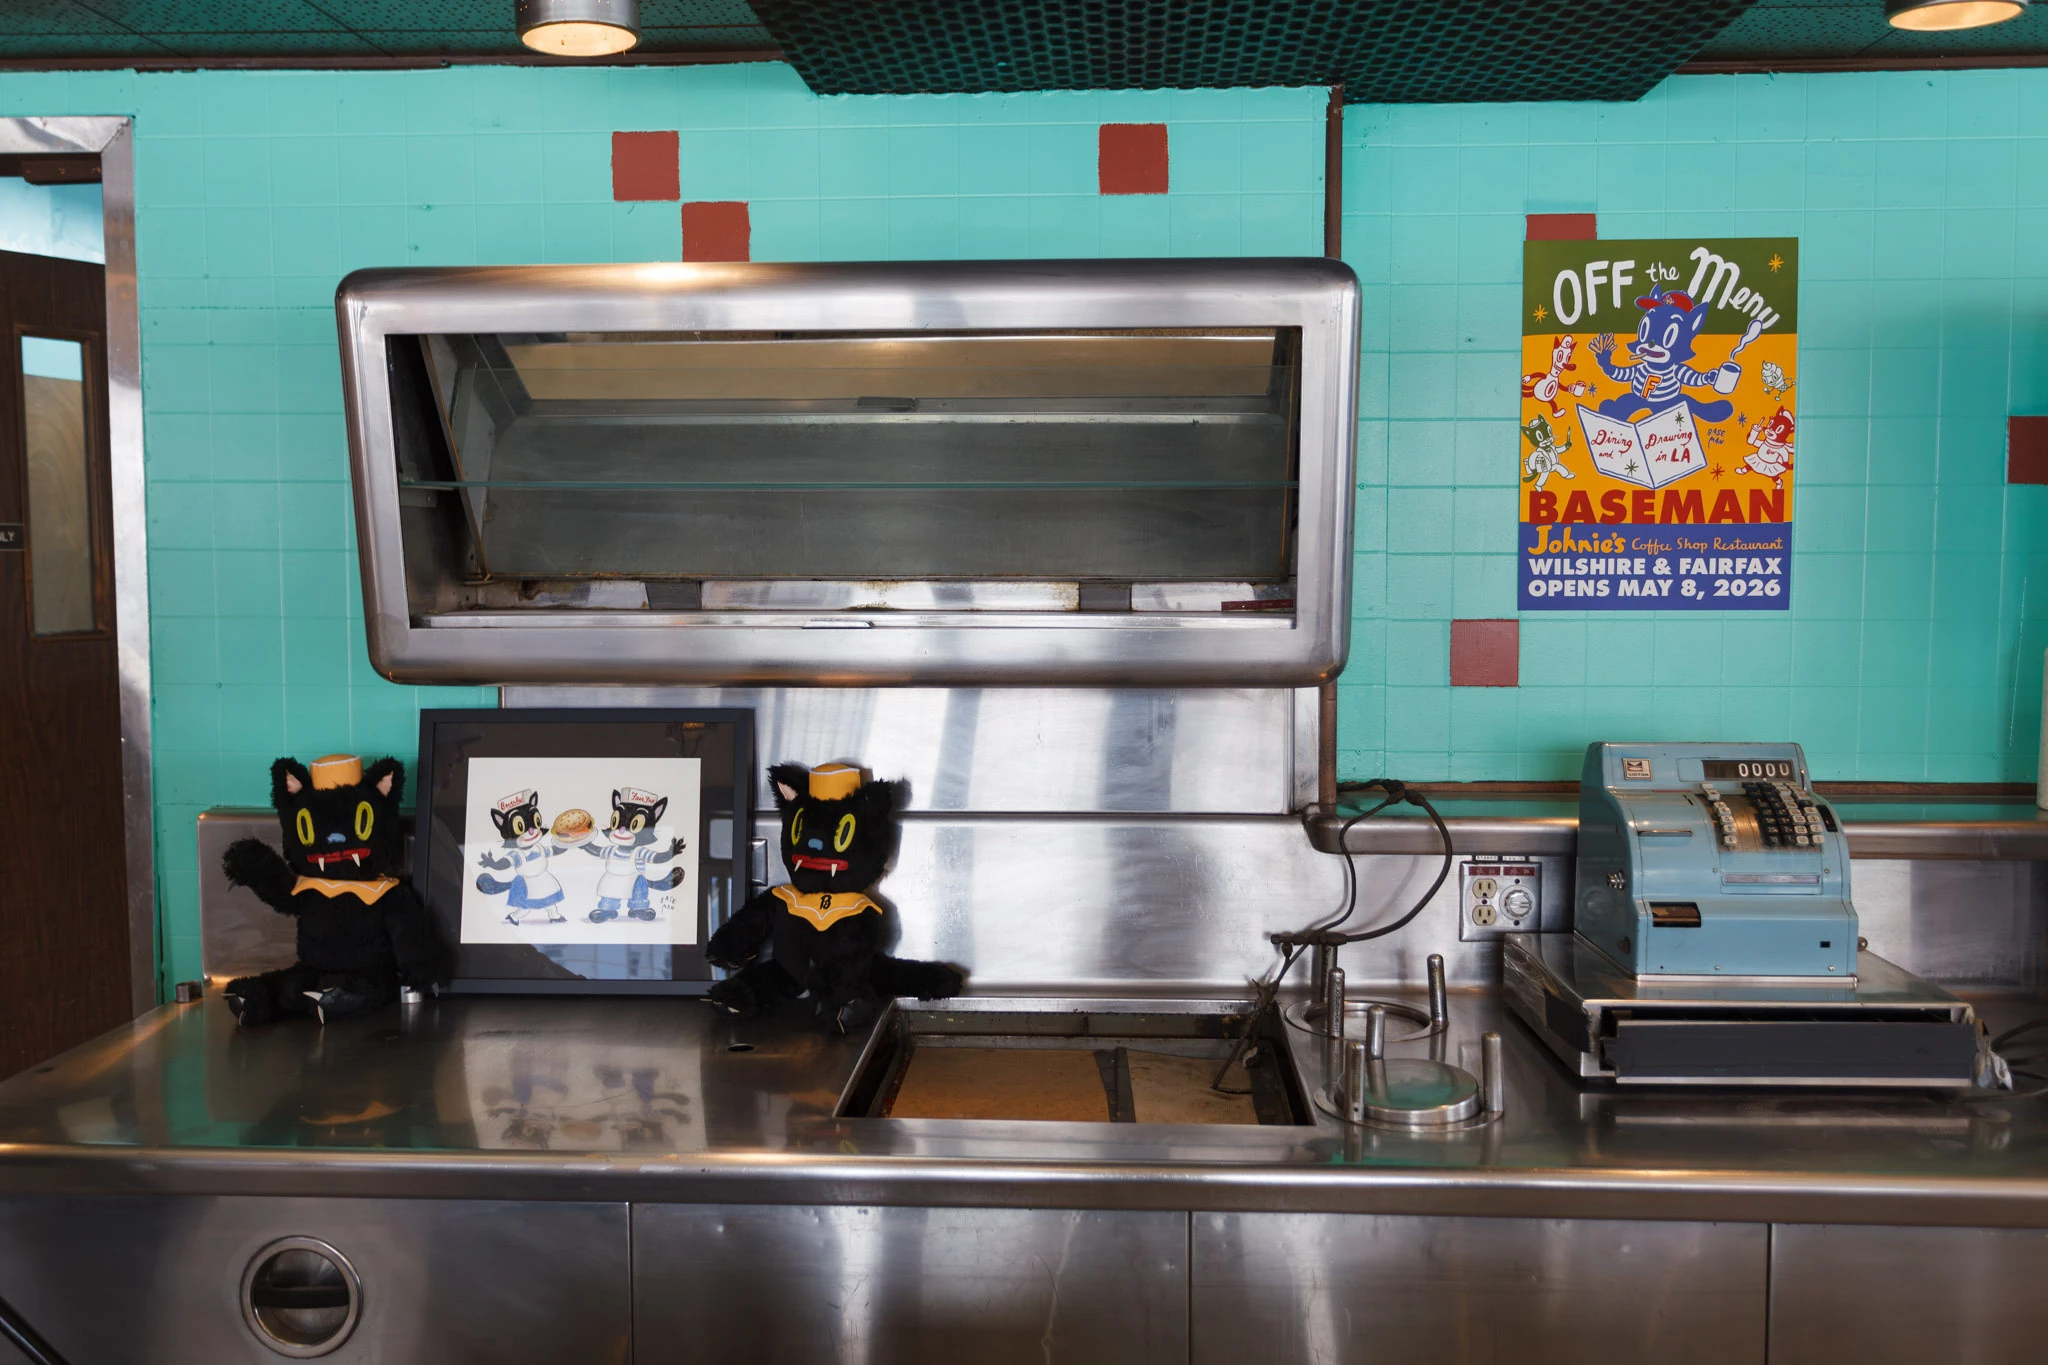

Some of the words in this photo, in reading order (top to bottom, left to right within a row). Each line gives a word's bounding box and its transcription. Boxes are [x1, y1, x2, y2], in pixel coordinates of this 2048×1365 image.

[1553, 259, 1636, 326] OFF
[1645, 261, 1680, 283] the
[1686, 246, 1780, 330] Menu
[1591, 429, 1633, 456] Dining
[1644, 428, 1693, 449] Drawing
[1598, 450, 1614, 460] and
[1655, 450, 1667, 462] in
[1670, 447, 1691, 463] LA
[1528, 488, 1785, 525] BASEMAN
[1527, 525, 1626, 556] Johnie's
[1631, 537, 1673, 555] Coffee
[1676, 536, 1709, 555] Shop
[1713, 536, 1784, 551] Restaurant
[1528, 557, 1646, 576] WILSHIRE
[1652, 557, 1673, 576] &
[1679, 557, 1783, 576] FAIRFAX
[1528, 579, 1610, 598] OPENS
[1617, 579, 1674, 597] MAY
[1680, 579, 1705, 601] 8,
[1712, 578, 1781, 597] 2026
[819, 894, 832, 910] B
